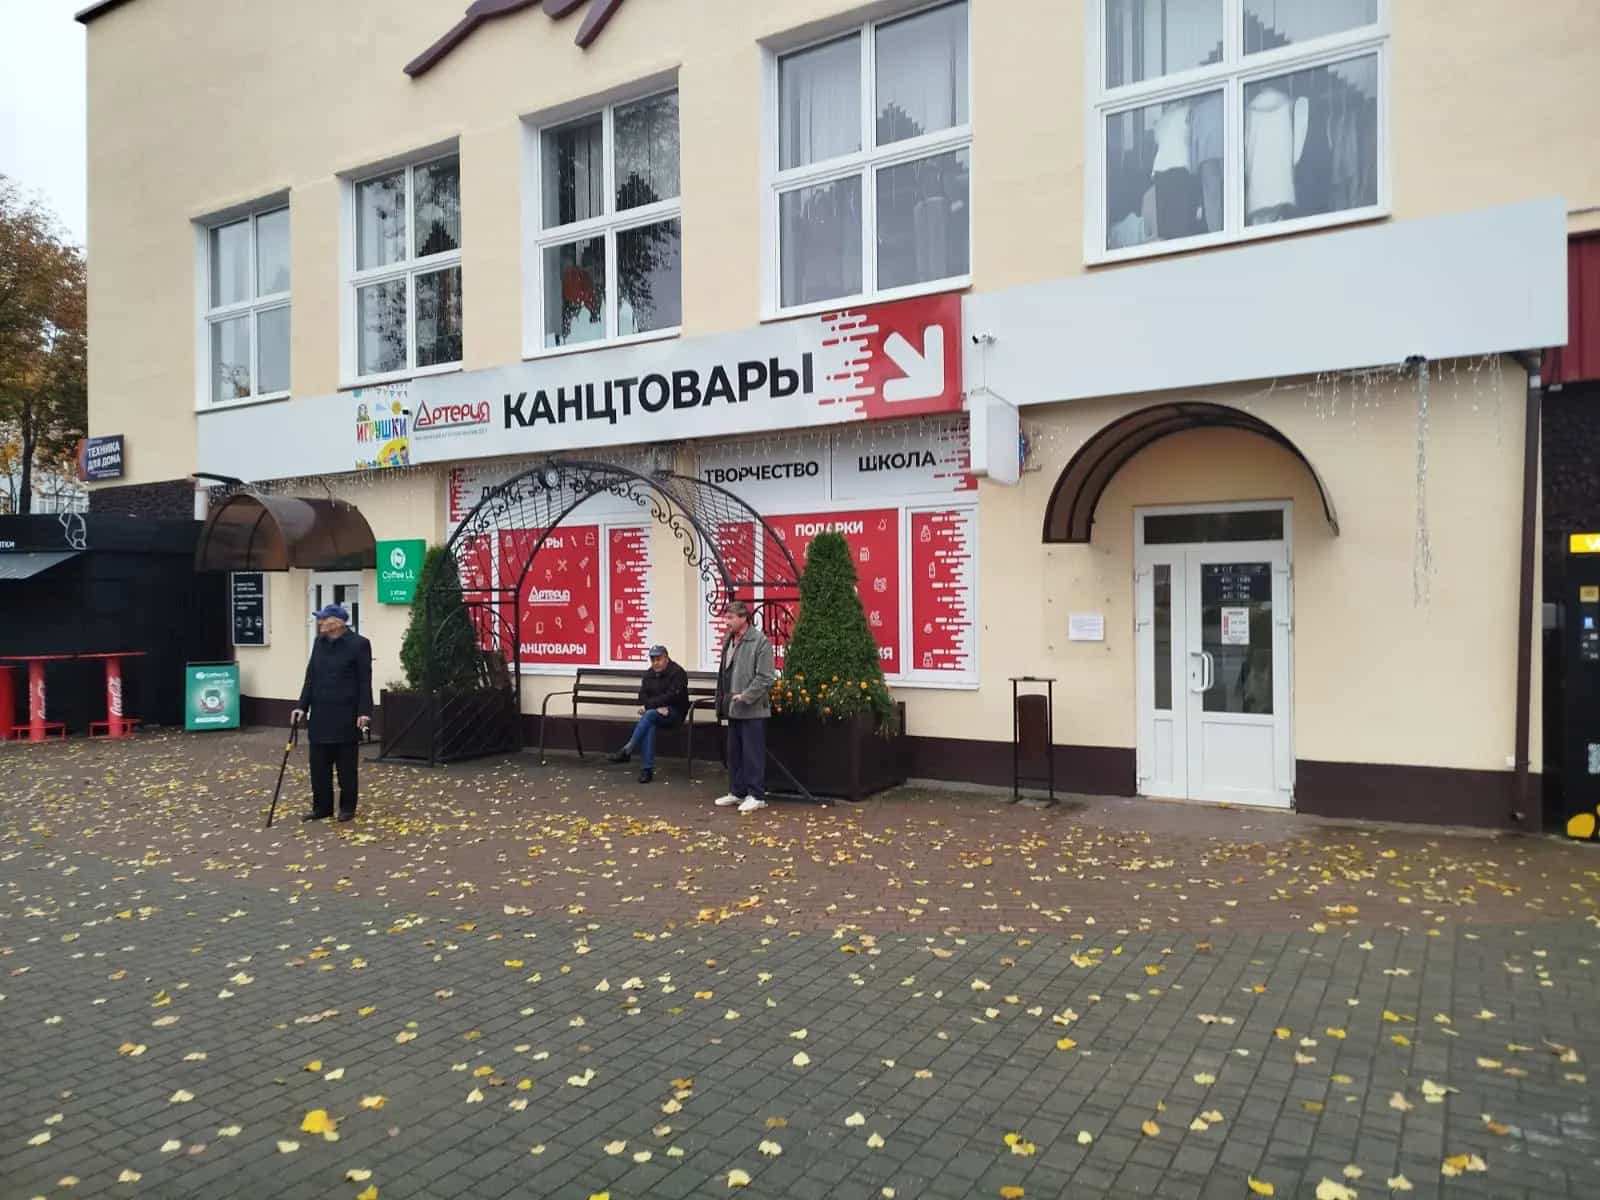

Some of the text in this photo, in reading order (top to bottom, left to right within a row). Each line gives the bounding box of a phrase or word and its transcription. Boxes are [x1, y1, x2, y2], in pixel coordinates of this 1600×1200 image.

[504, 351, 814, 430] КАНЦТОВАРЫ
[356, 417, 408, 443] ИГРУШКИ
[87, 441, 120, 457] ТЕХНИКА
[87, 453, 121, 471] ДЛЯ ДОМА
[704, 461, 820, 484] ТВОРЧЕСТВО
[858, 451, 937, 473] ШКОЛА
[518, 642, 588, 657] АНЦТОВАРЫ
